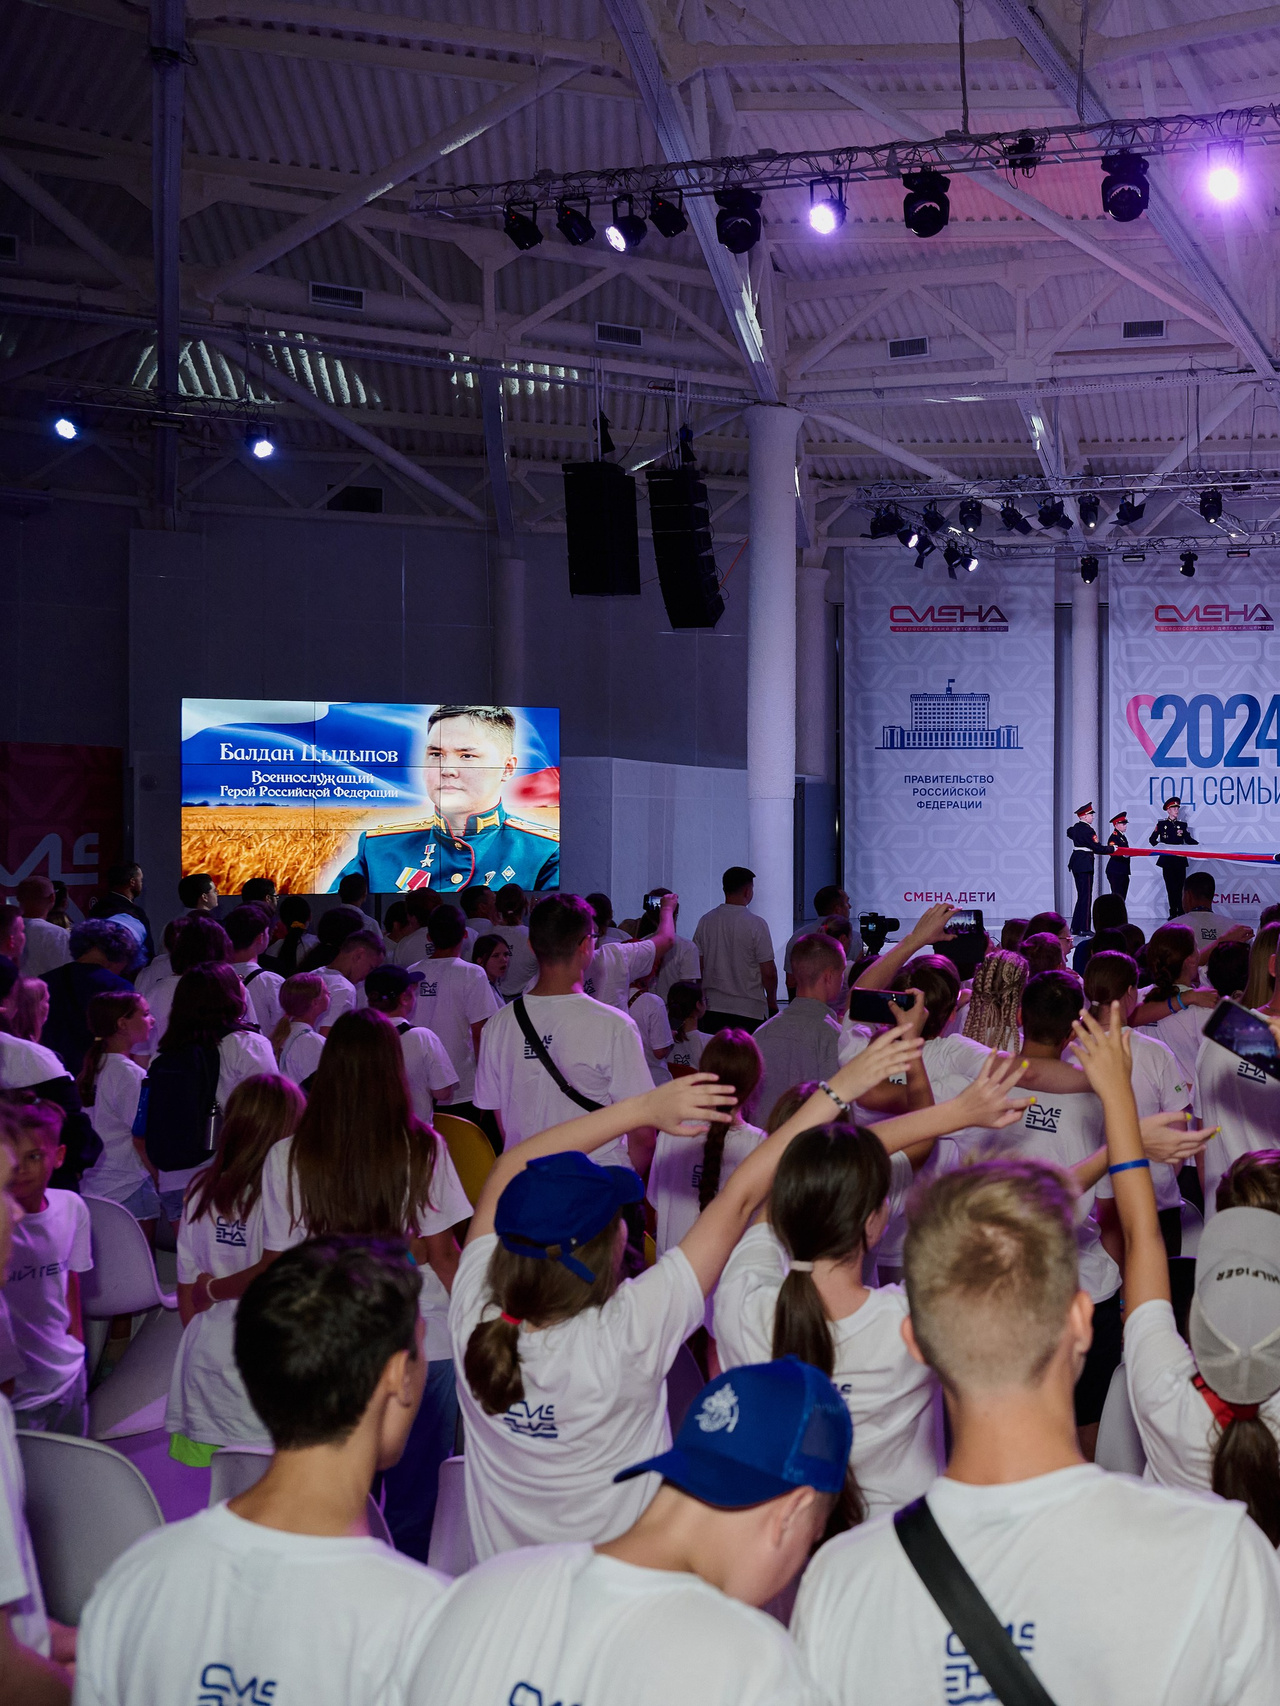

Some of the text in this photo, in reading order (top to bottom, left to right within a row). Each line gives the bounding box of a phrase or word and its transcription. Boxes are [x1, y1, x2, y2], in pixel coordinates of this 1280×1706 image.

[219, 743, 399, 764] Балдан Цыдыпов
[251, 770, 375, 786] Военнослужащий
[904, 775, 995, 784] ПРАВИТЕЛЬСТВО
[219, 785, 399, 800] Герой Российской Федерации
[912, 786, 986, 797] РОССИЙСКОЙ
[916, 800, 983, 811] ФЕДЕРАЦИИ
[903, 891, 996, 904] СМЕНА.ДЕТИ
[1212, 893, 1261, 904] СМЕНА
